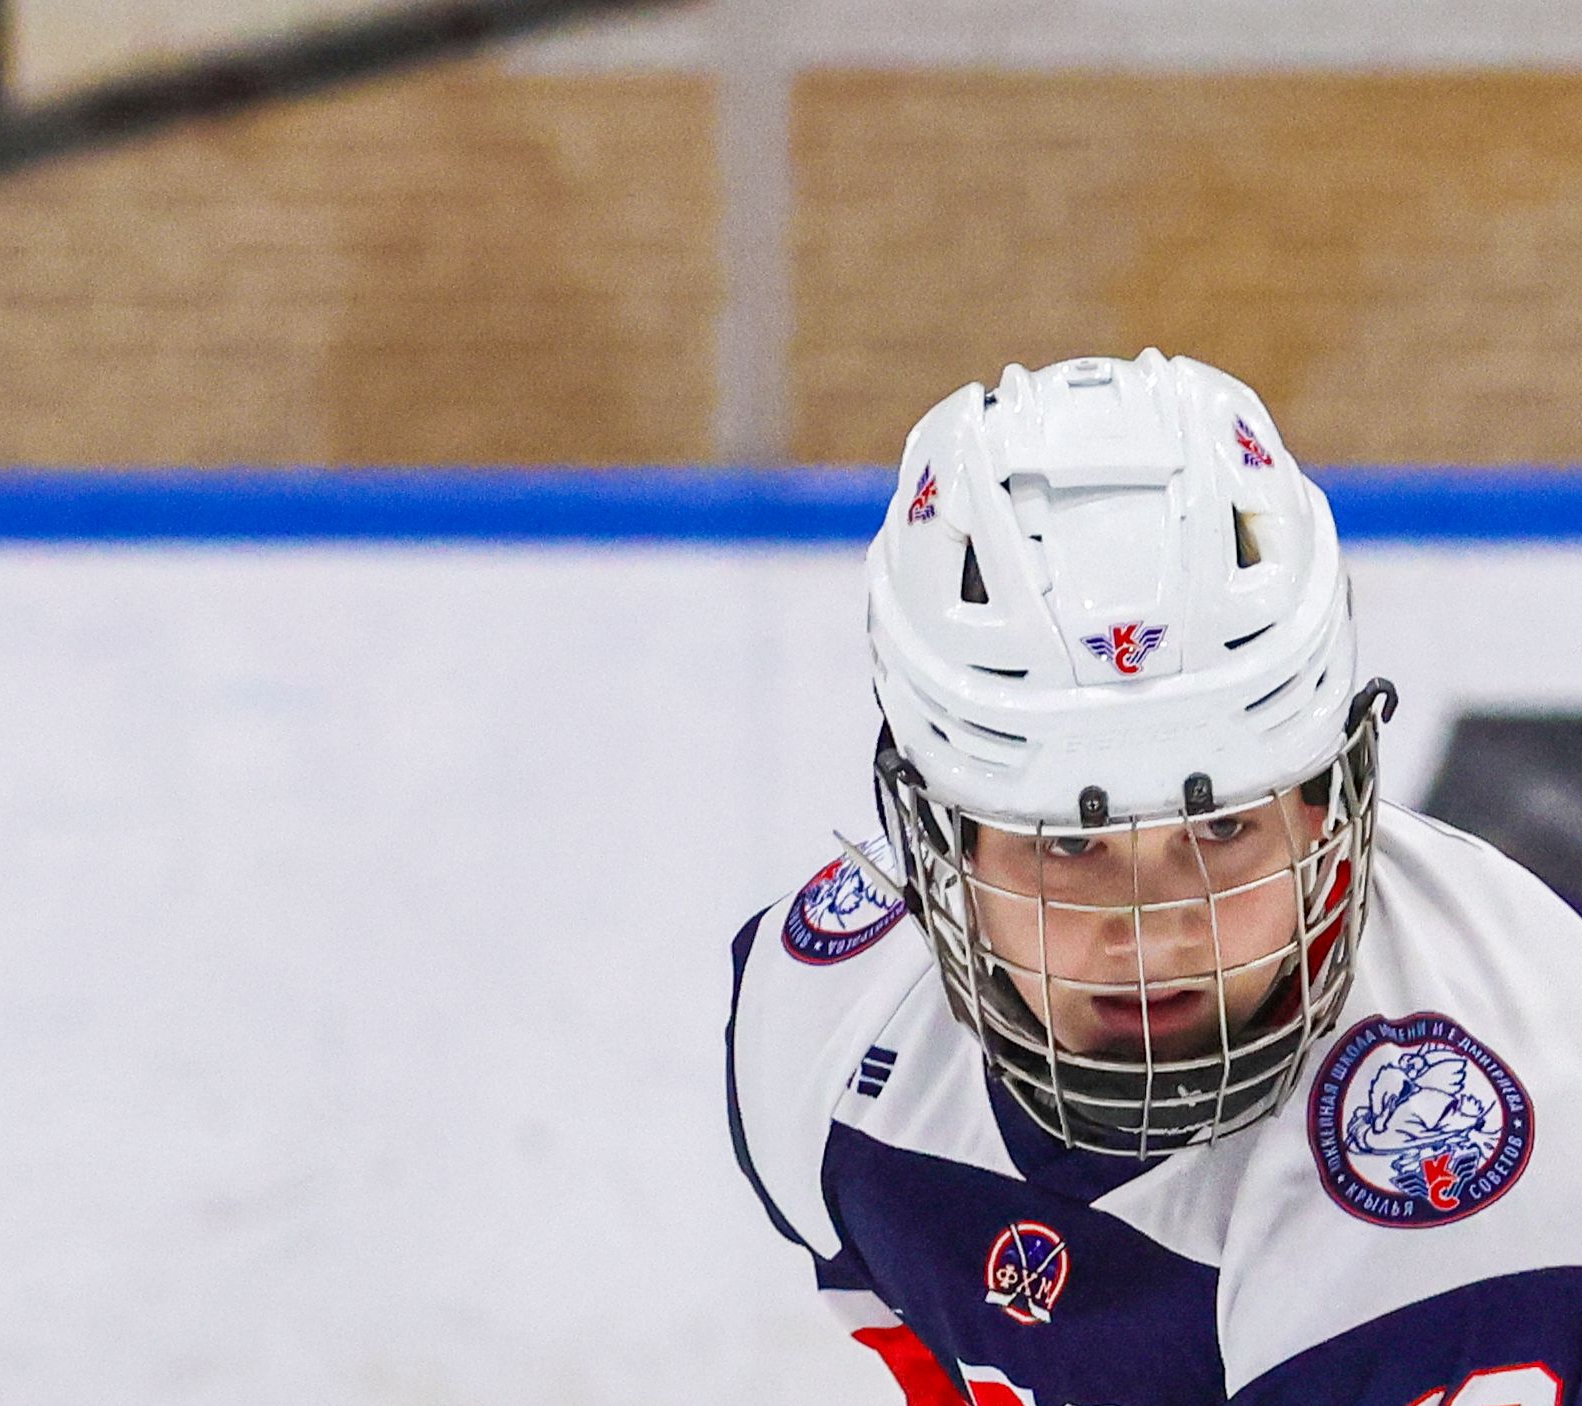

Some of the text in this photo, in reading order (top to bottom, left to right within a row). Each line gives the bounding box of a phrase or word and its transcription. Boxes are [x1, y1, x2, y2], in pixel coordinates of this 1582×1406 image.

[1330, 1029, 1377, 1081] ШКОЛА
[1458, 1036, 1524, 1112] ДМИТРИЕВА
[1345, 1134, 1524, 1217] КРЫЛЬЯ СОВЕТОВ
